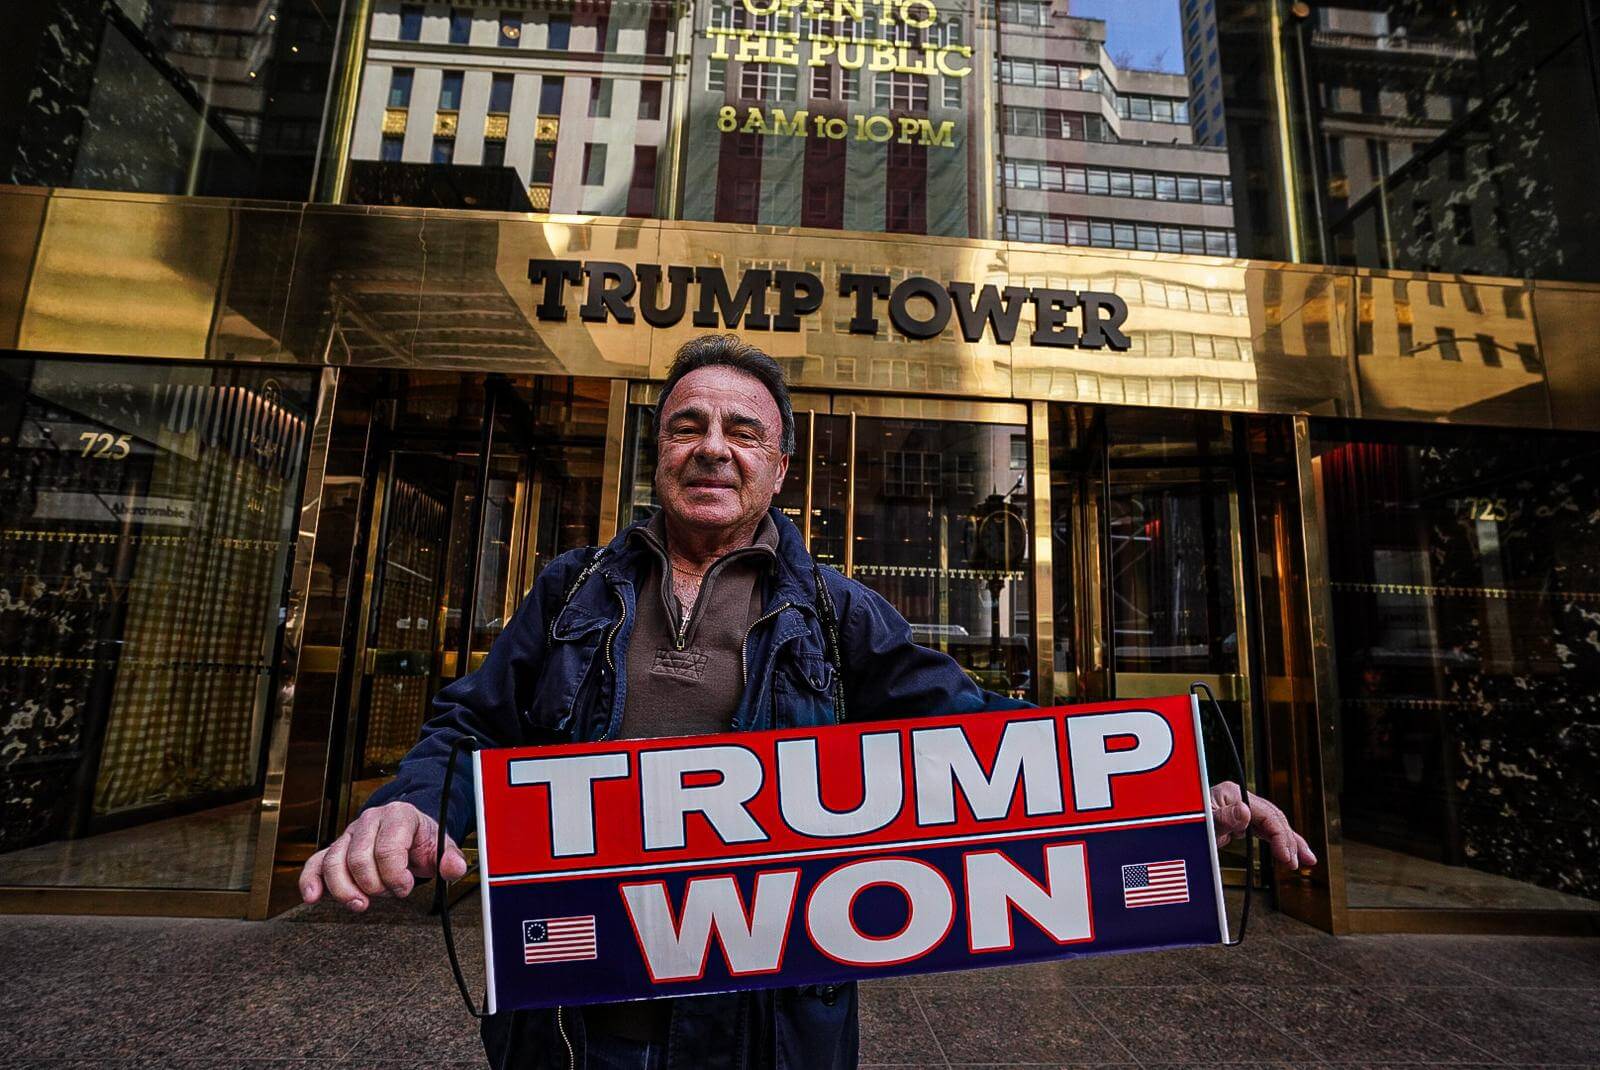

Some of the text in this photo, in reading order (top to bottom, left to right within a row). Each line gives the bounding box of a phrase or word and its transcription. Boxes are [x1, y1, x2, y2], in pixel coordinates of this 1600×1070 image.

[872, 0, 938, 29] TO
[706, 26, 973, 78] THE PUBLIC
[717, 105, 955, 148] 8 AM to 10 PM
[528, 258, 1132, 352] TRUMP TOWER
[79, 431, 134, 462] 725
[508, 710, 1174, 858] TRUMP
[620, 842, 1094, 982] WON
